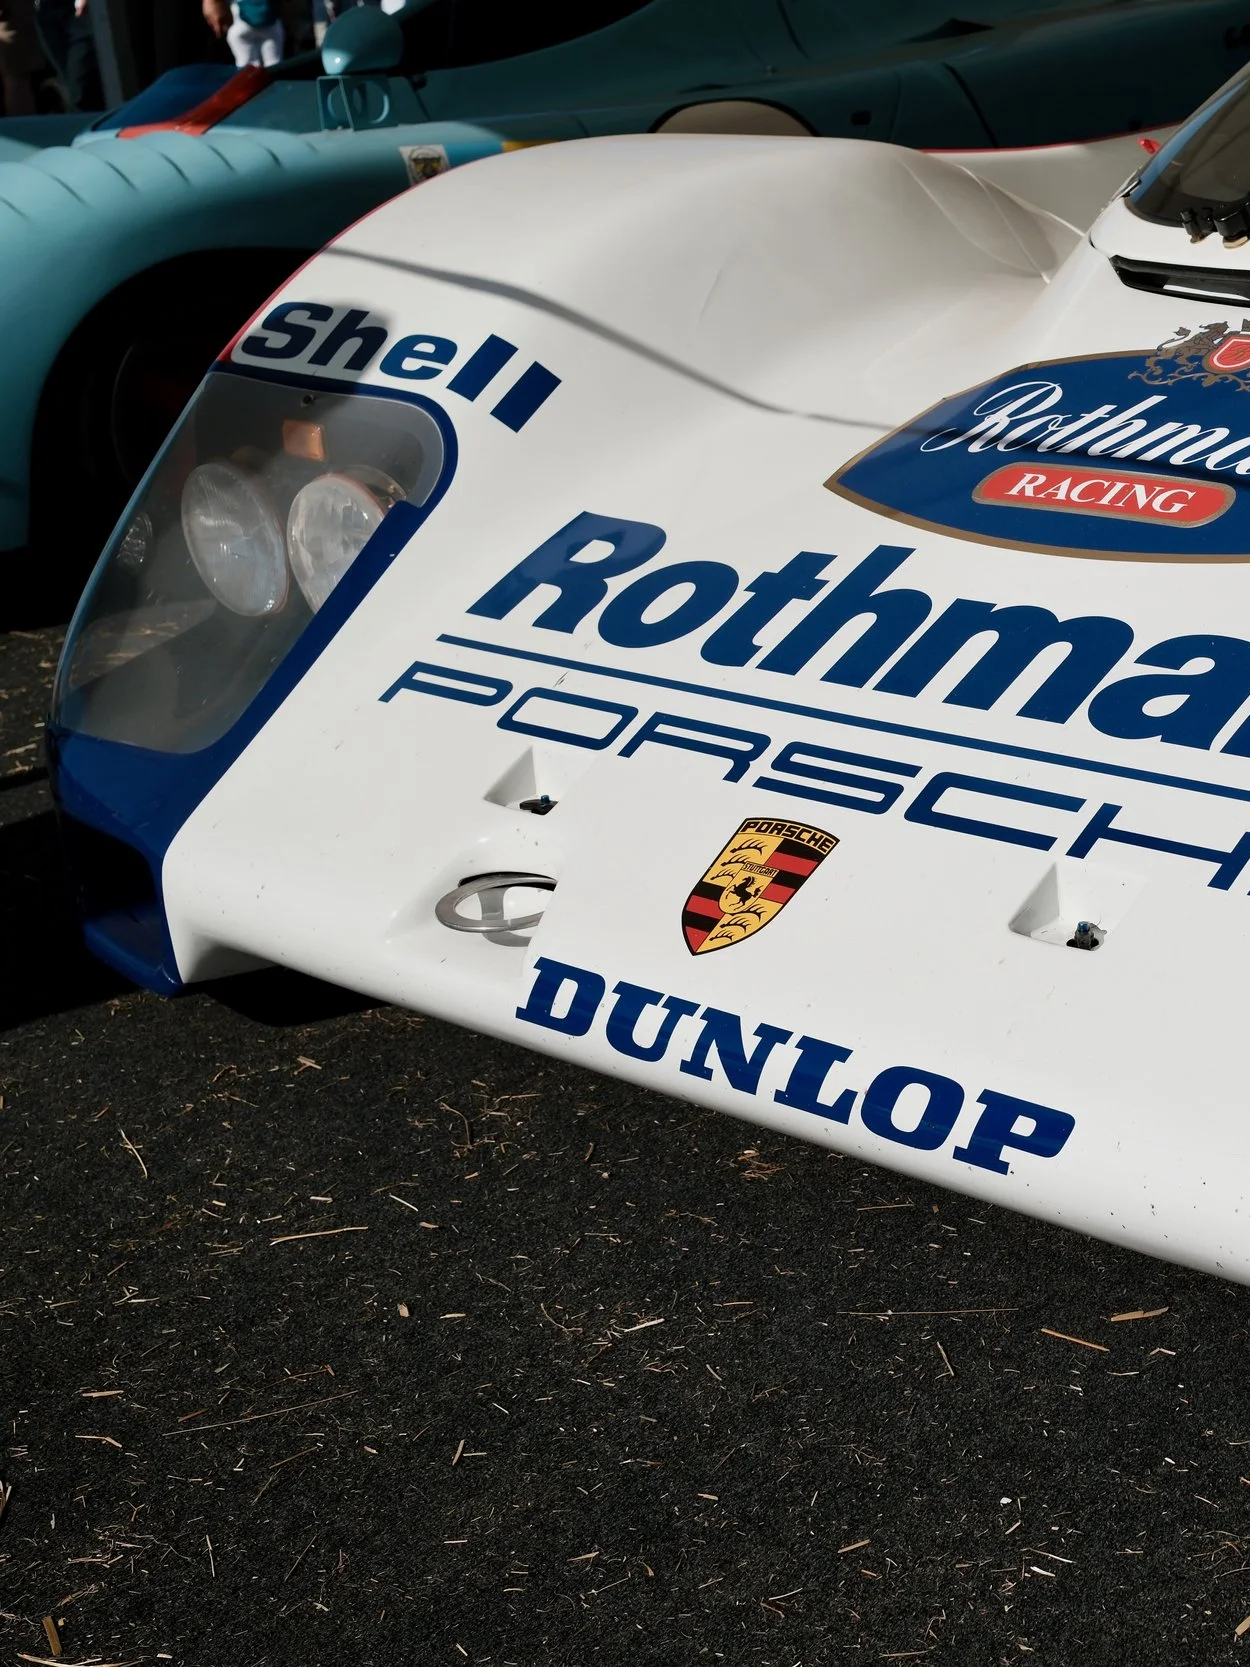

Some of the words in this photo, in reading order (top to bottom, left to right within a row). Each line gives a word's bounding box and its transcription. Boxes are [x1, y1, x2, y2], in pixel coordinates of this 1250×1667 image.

[239, 302, 562, 433] Shell
[1004, 472, 1197, 514] RACING
[740, 821, 835, 854] PORSCHE
[744, 863, 779, 878] STUTTGART
[516, 957, 1075, 1175] DUNLOP
